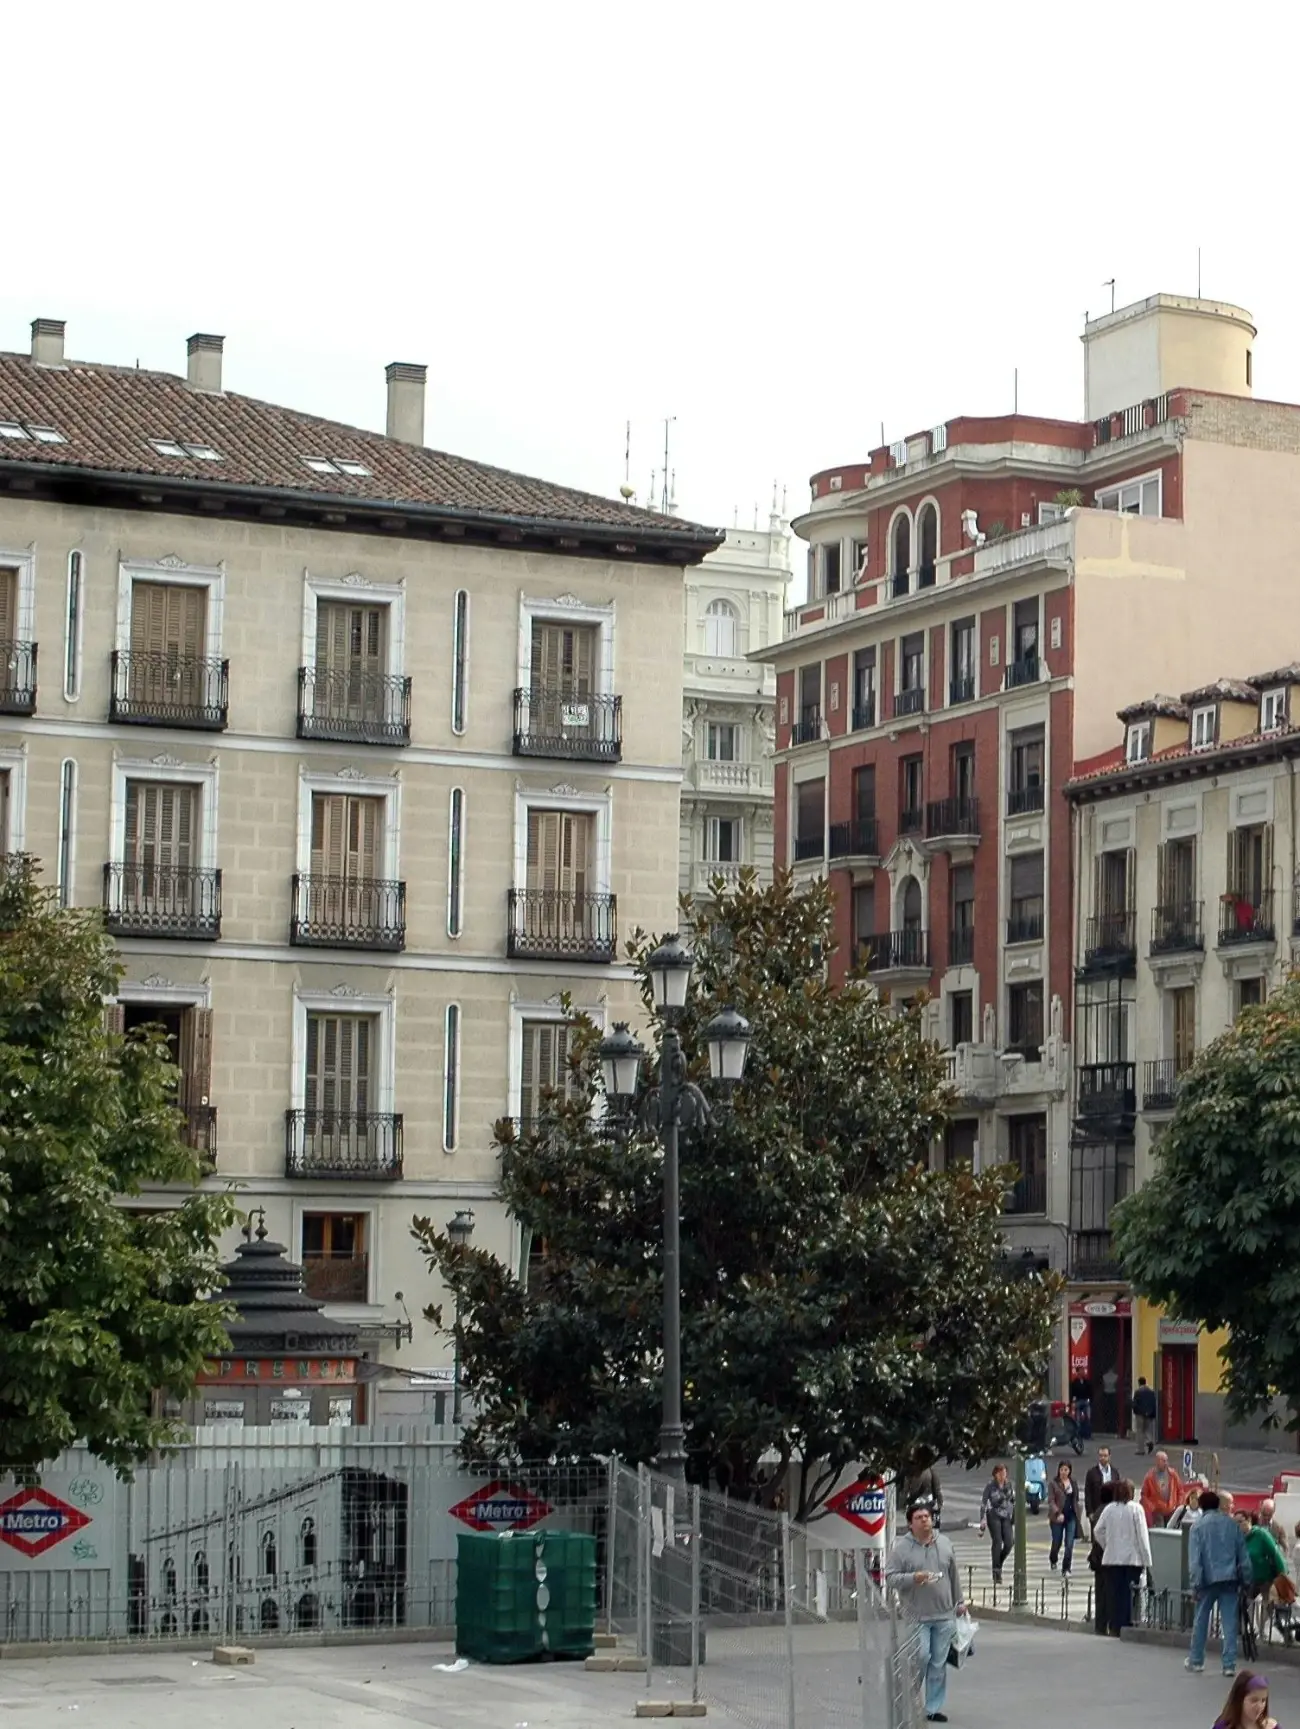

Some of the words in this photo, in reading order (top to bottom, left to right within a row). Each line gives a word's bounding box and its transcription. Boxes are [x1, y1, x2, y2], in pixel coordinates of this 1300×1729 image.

[219, 1360, 349, 1378] PRENSA
[479, 1502, 524, 1519] Metro
[851, 1494, 885, 1512] Metr
[7, 1513, 59, 1529] Metro
